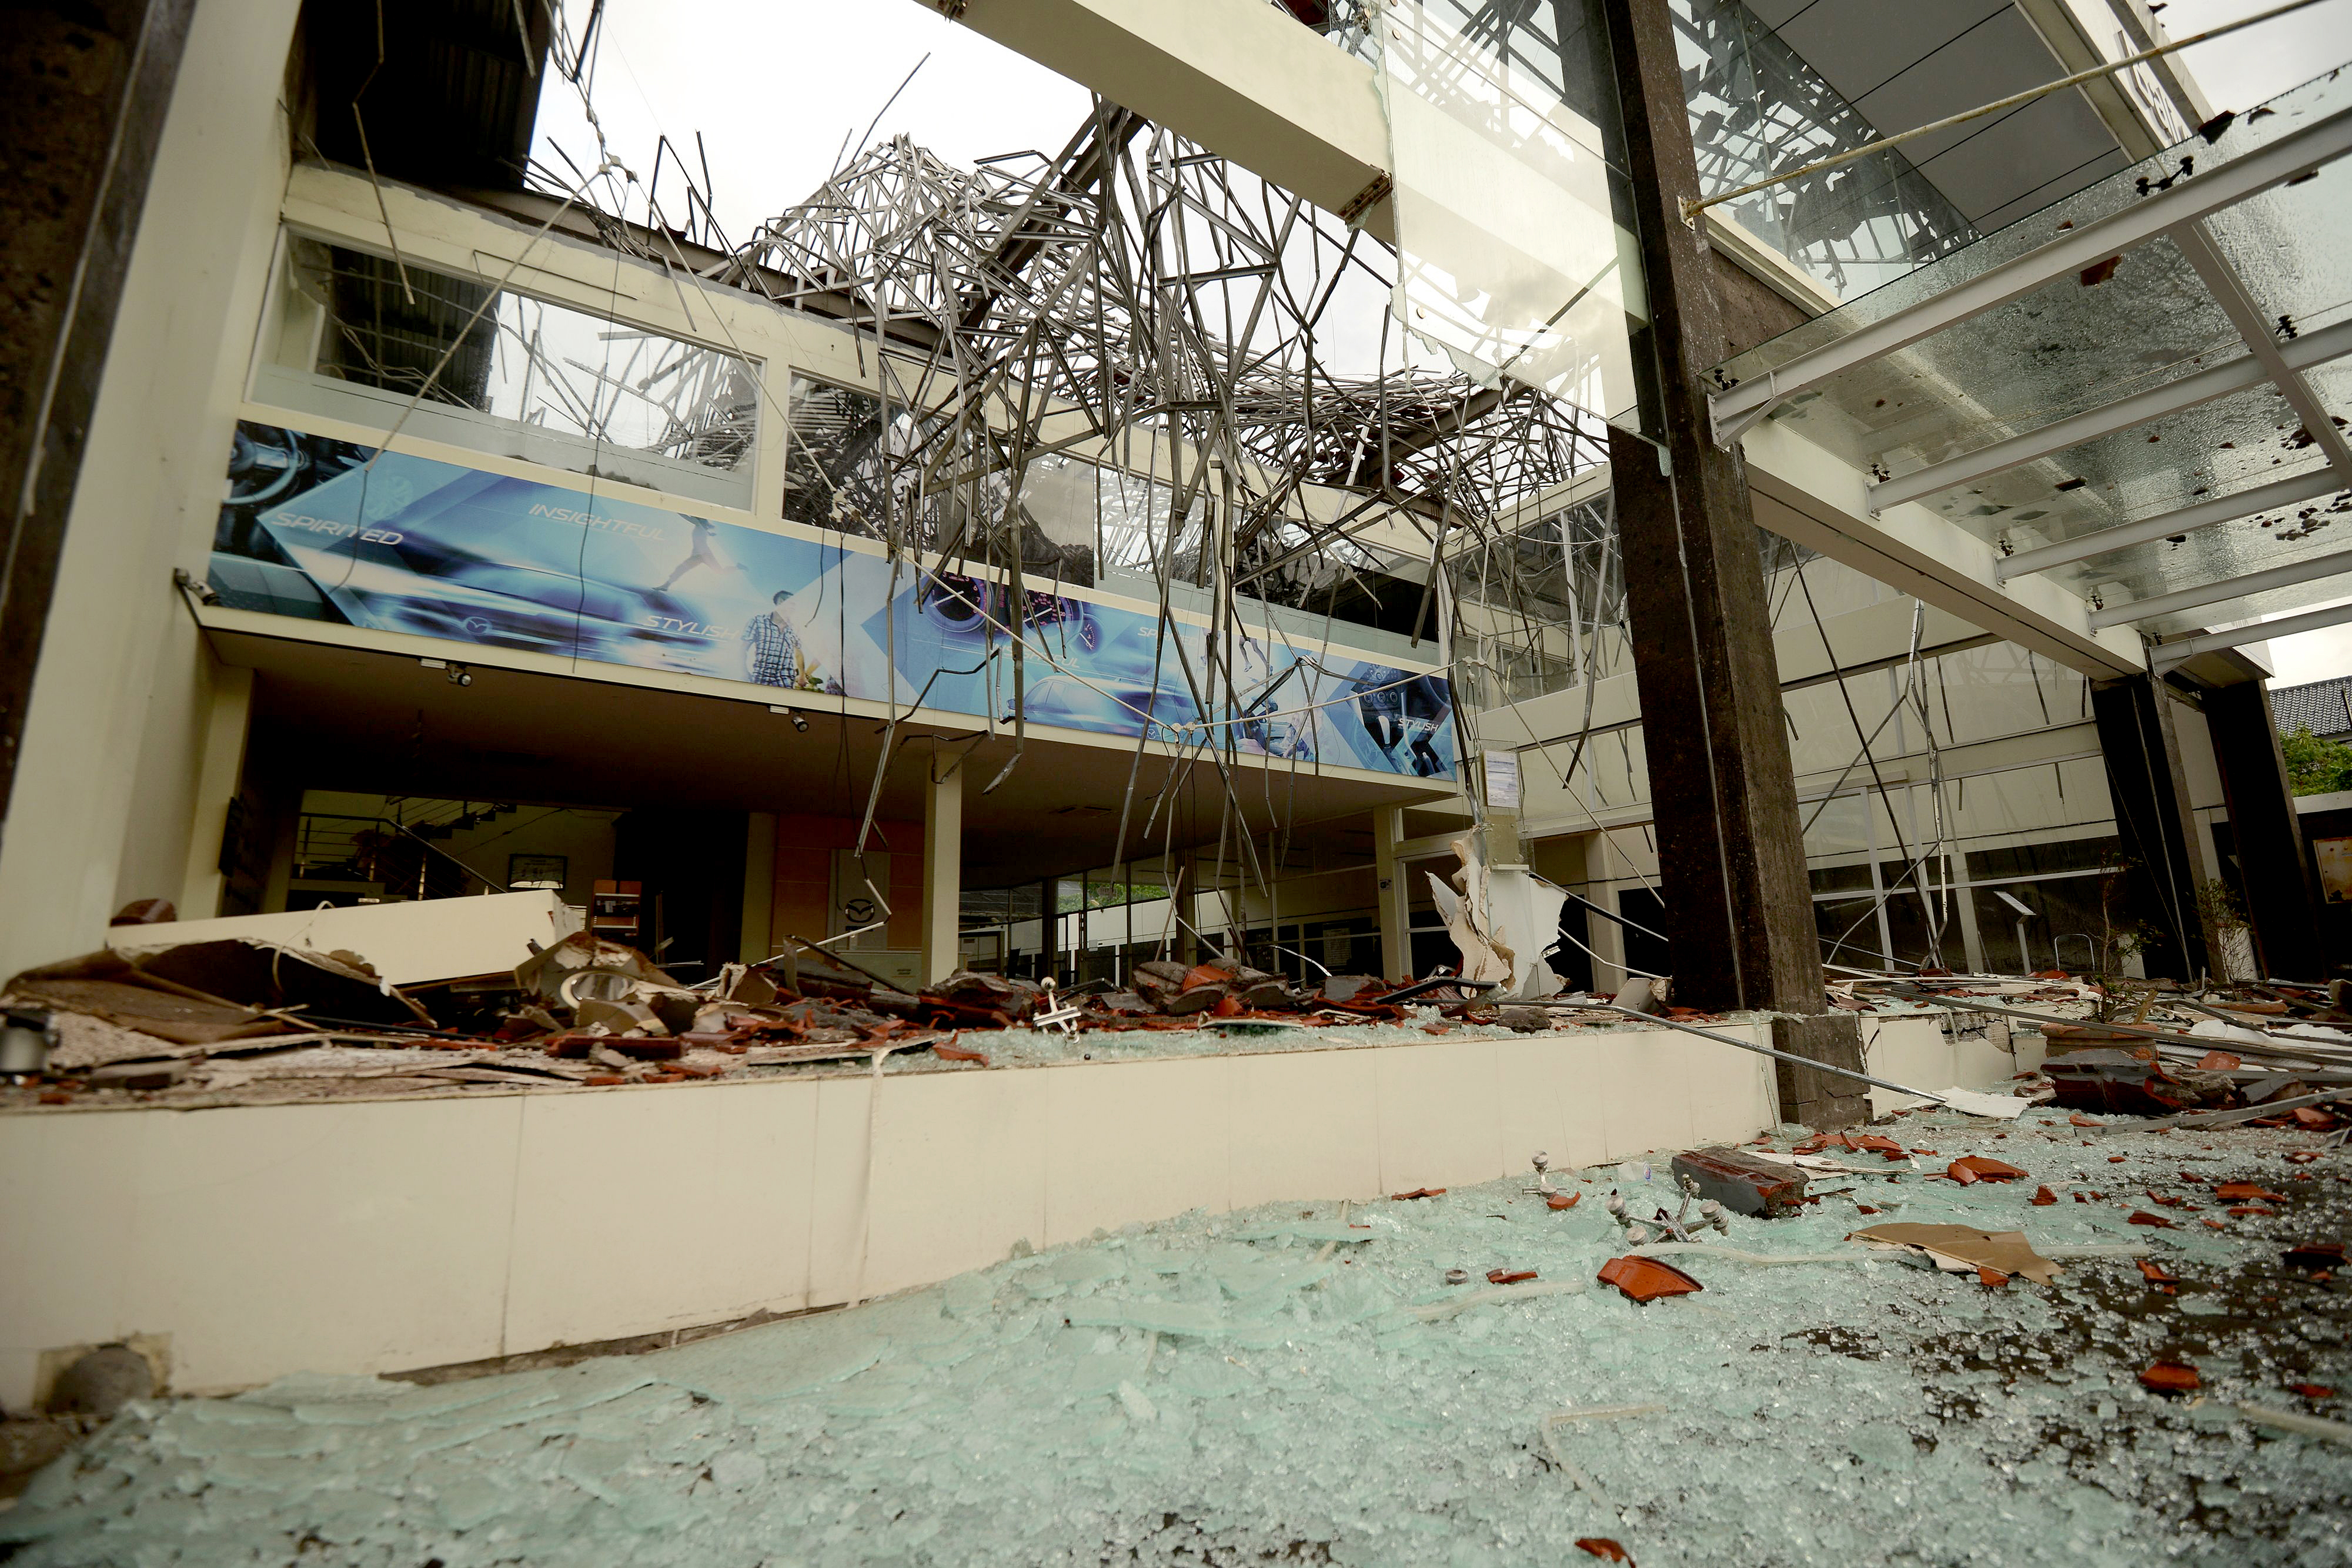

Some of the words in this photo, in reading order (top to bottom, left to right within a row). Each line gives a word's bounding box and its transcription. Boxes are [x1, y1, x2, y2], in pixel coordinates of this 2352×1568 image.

[271, 513, 404, 545] SPIRITED
[529, 504, 666, 541] INSIGHTFUL
[643, 615, 740, 640] STYLISH
[1137, 626, 1197, 646] SPRIED
[1398, 718, 1439, 732] STYLISH
